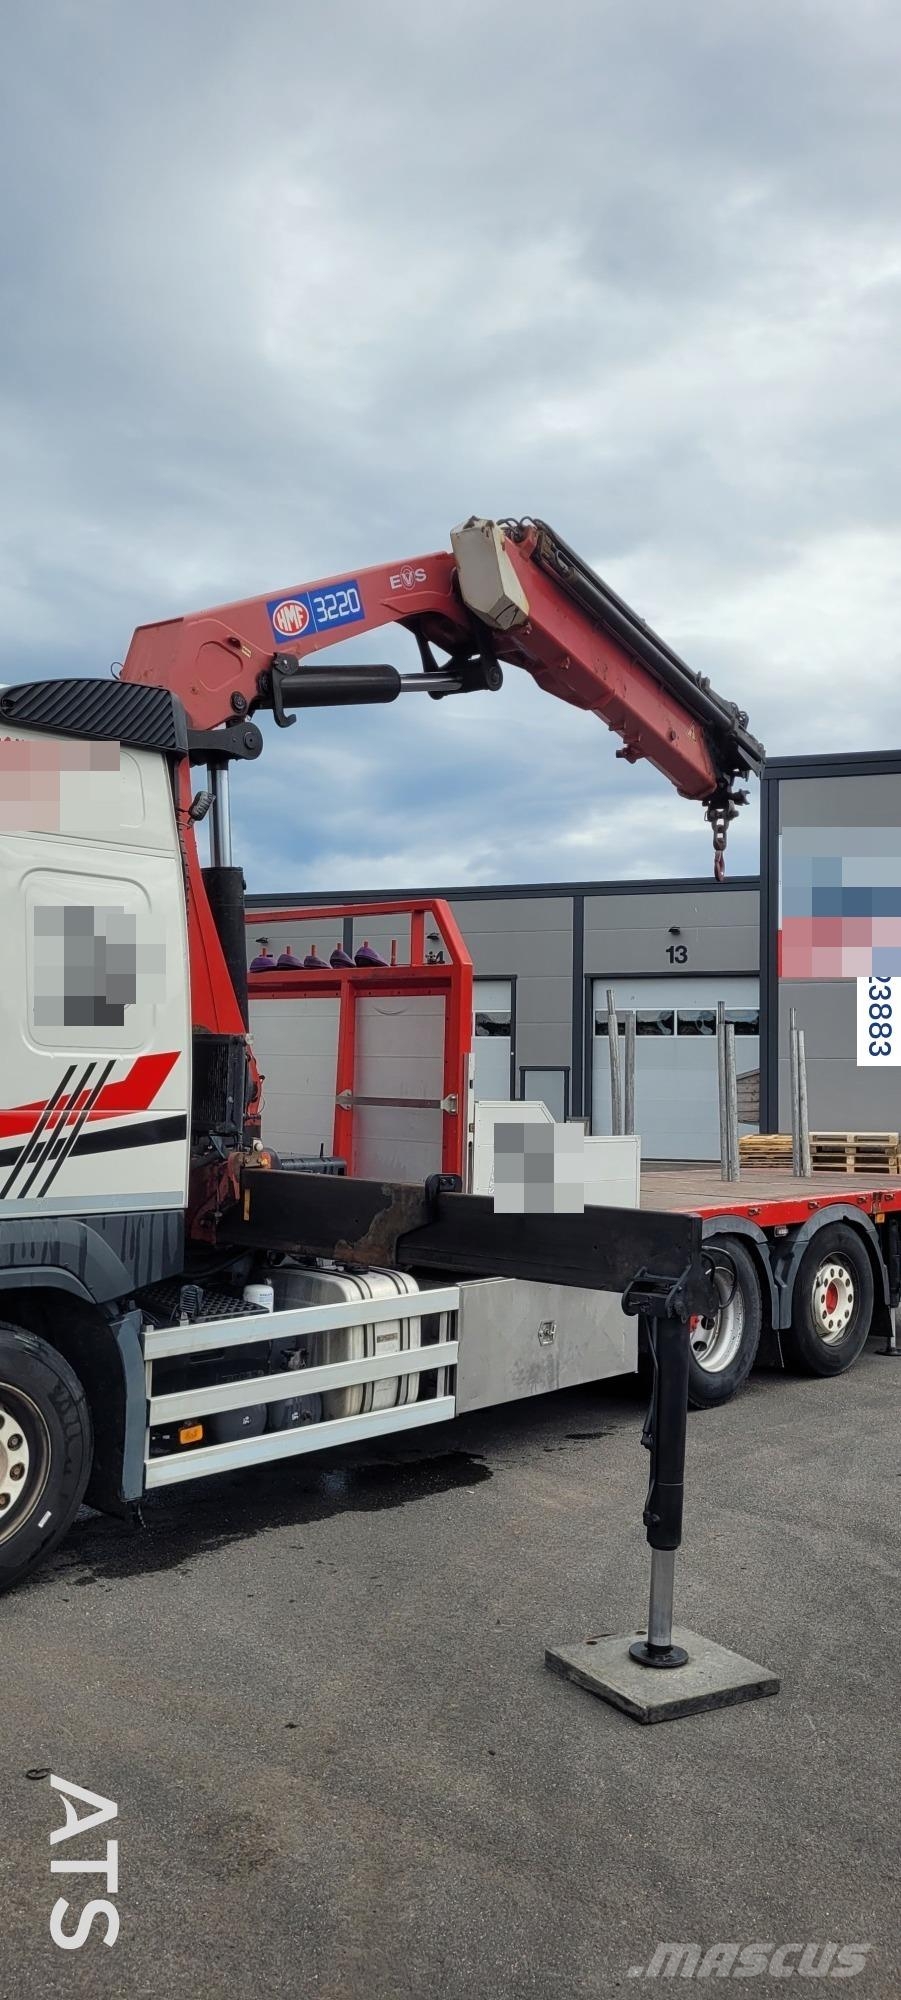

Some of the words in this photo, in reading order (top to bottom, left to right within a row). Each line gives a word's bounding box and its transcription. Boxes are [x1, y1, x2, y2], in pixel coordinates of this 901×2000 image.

[389, 568, 427, 589] EVS
[276, 604, 304, 632] HMF
[313, 588, 361, 623] 3220
[665, 945, 688, 964] 13
